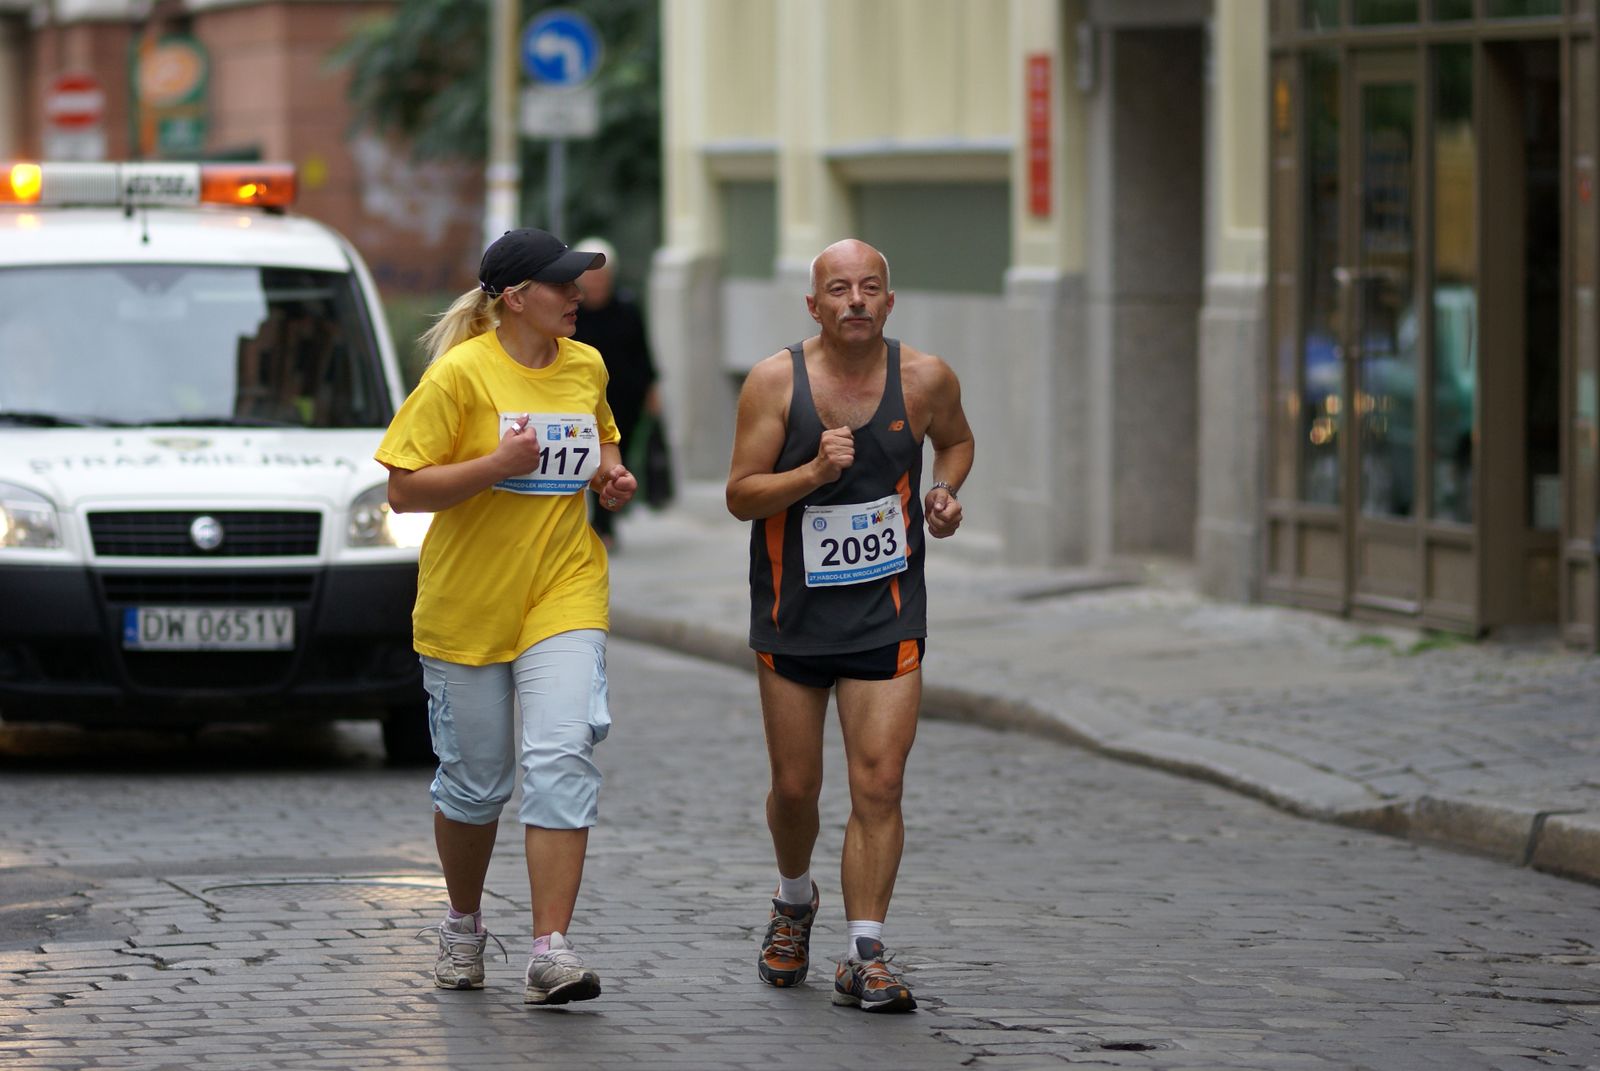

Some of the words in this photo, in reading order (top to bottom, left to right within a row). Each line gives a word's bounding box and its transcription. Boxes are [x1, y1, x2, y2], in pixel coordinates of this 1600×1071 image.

[539, 446, 590, 476] 117
[820, 527, 898, 567] 2093
[142, 610, 187, 642] DW
[196, 610, 289, 642] 0651V
